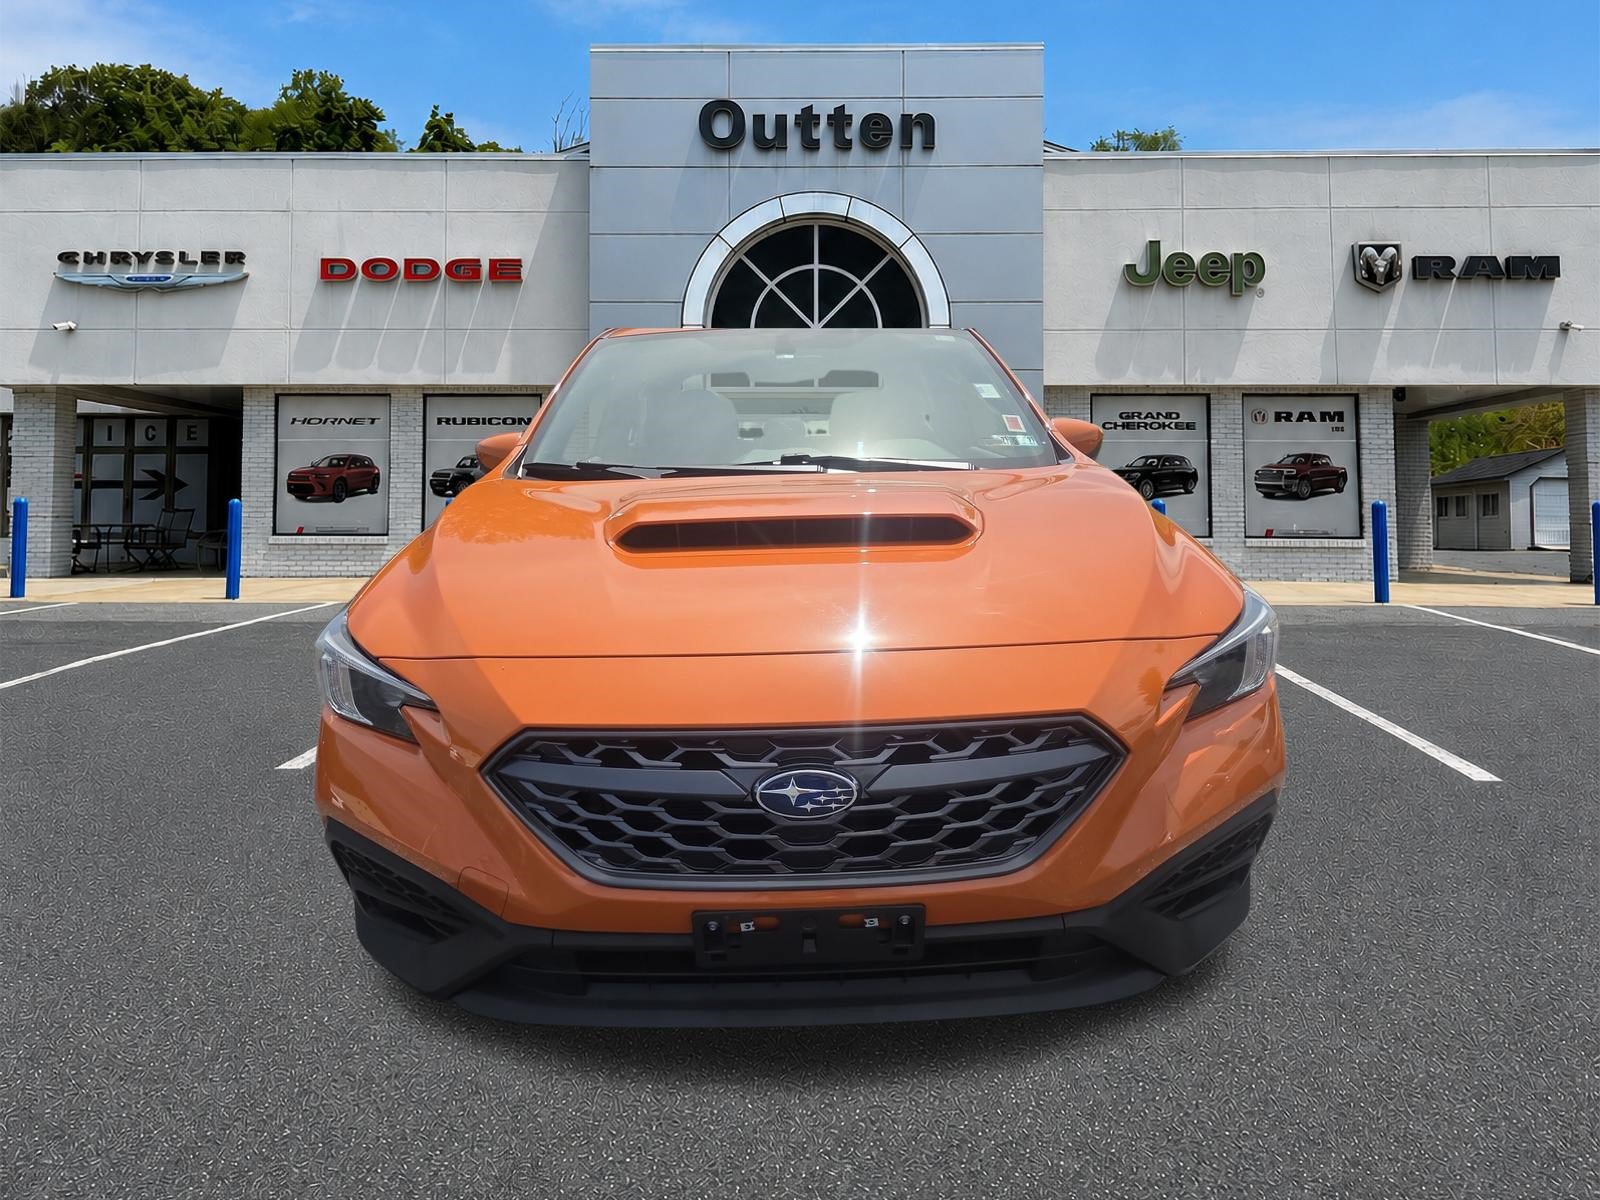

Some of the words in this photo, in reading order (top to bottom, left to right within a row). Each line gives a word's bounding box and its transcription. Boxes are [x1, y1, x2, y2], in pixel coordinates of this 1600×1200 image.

[699, 99, 935, 150] Outten
[56, 251, 247, 266] CHRYSLER
[320, 257, 523, 282] DODGE
[1123, 240, 1266, 297] Jeep
[1411, 255, 1561, 280] RAM
[290, 417, 381, 426] HORNET
[436, 417, 534, 426] RUBICON
[1118, 411, 1180, 420] GRAND
[1274, 411, 1345, 423] RAM
[1102, 421, 1197, 430] CHEROKEE
